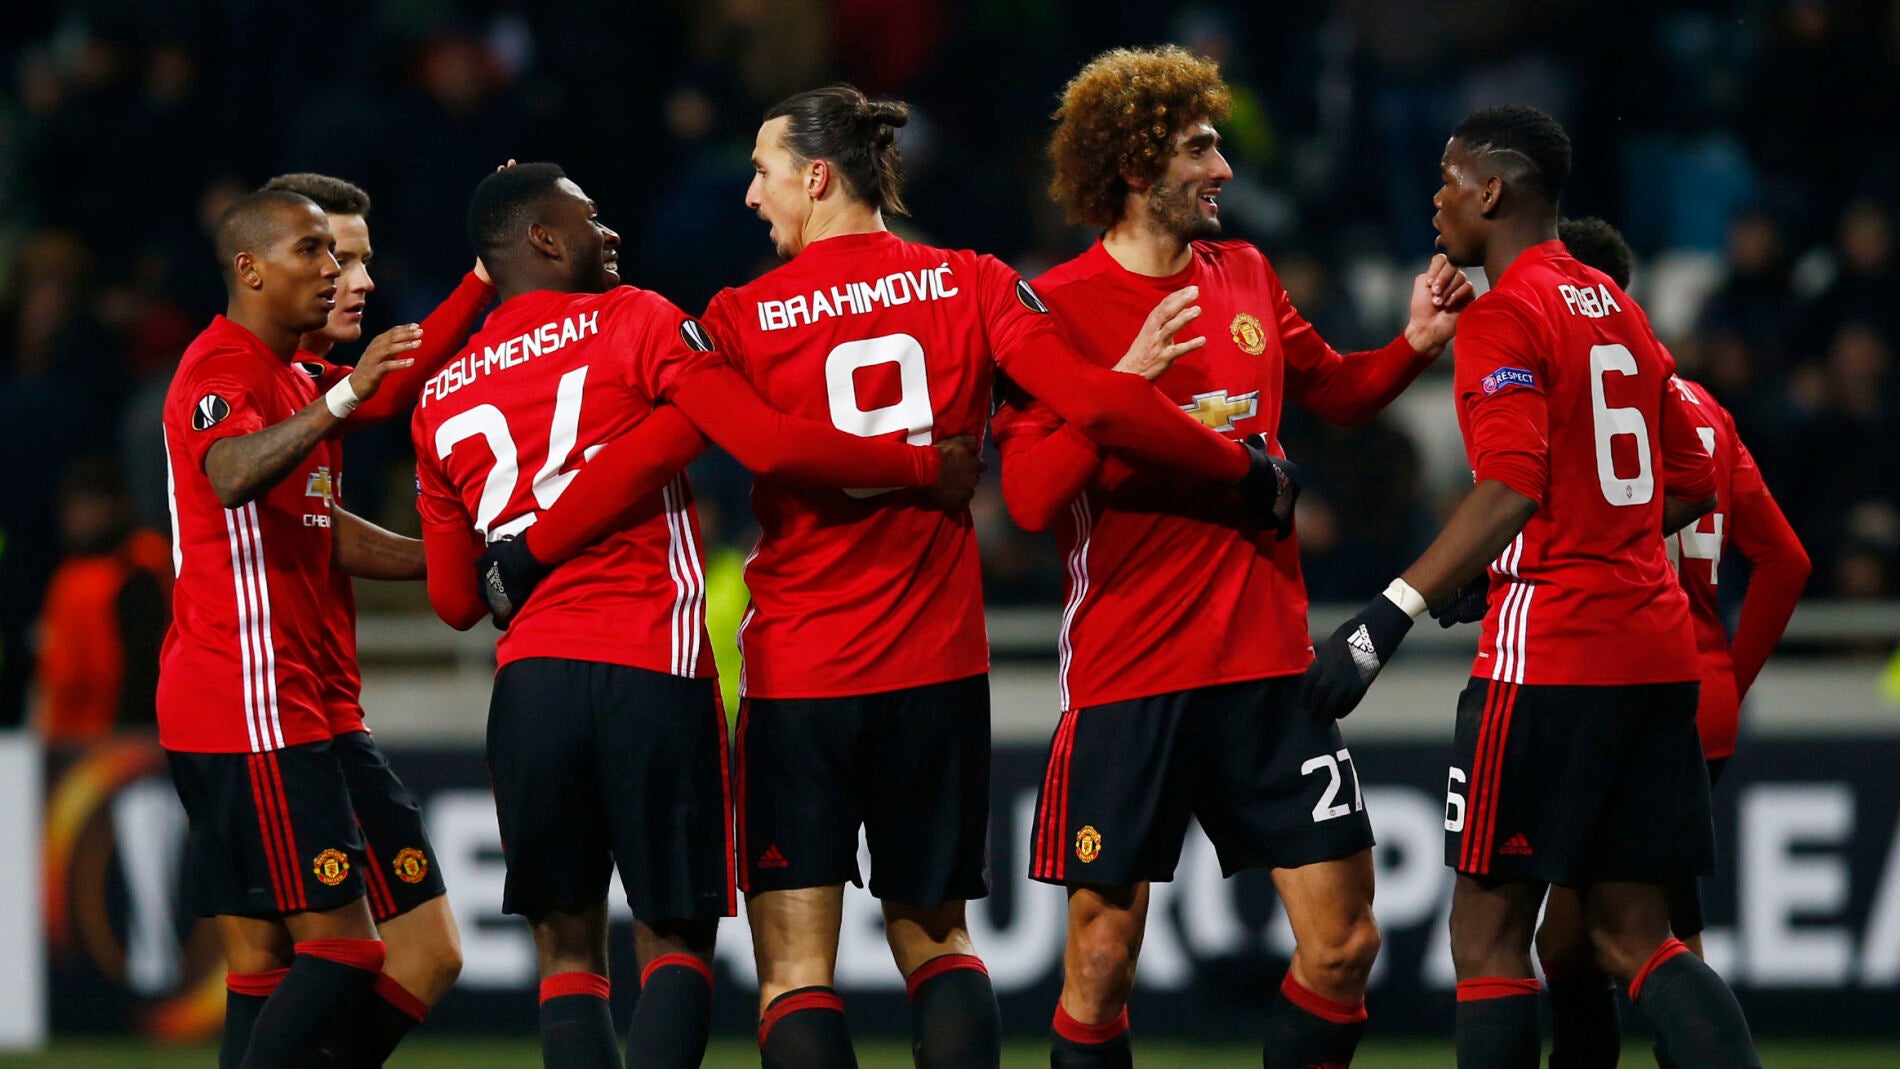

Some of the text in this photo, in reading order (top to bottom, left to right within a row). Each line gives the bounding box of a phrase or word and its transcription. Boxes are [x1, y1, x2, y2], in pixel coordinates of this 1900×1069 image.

[757, 262, 959, 331] IBRAHIMOVIĆ
[422, 311, 599, 409] FOSU-MENSAH
[1495, 371, 1534, 384] RESPECT
[435, 365, 608, 543] 24
[825, 333, 934, 498] 9
[1590, 344, 1654, 507] 6
[1301, 748, 1363, 822] 27
[1444, 766, 1467, 832] 6
